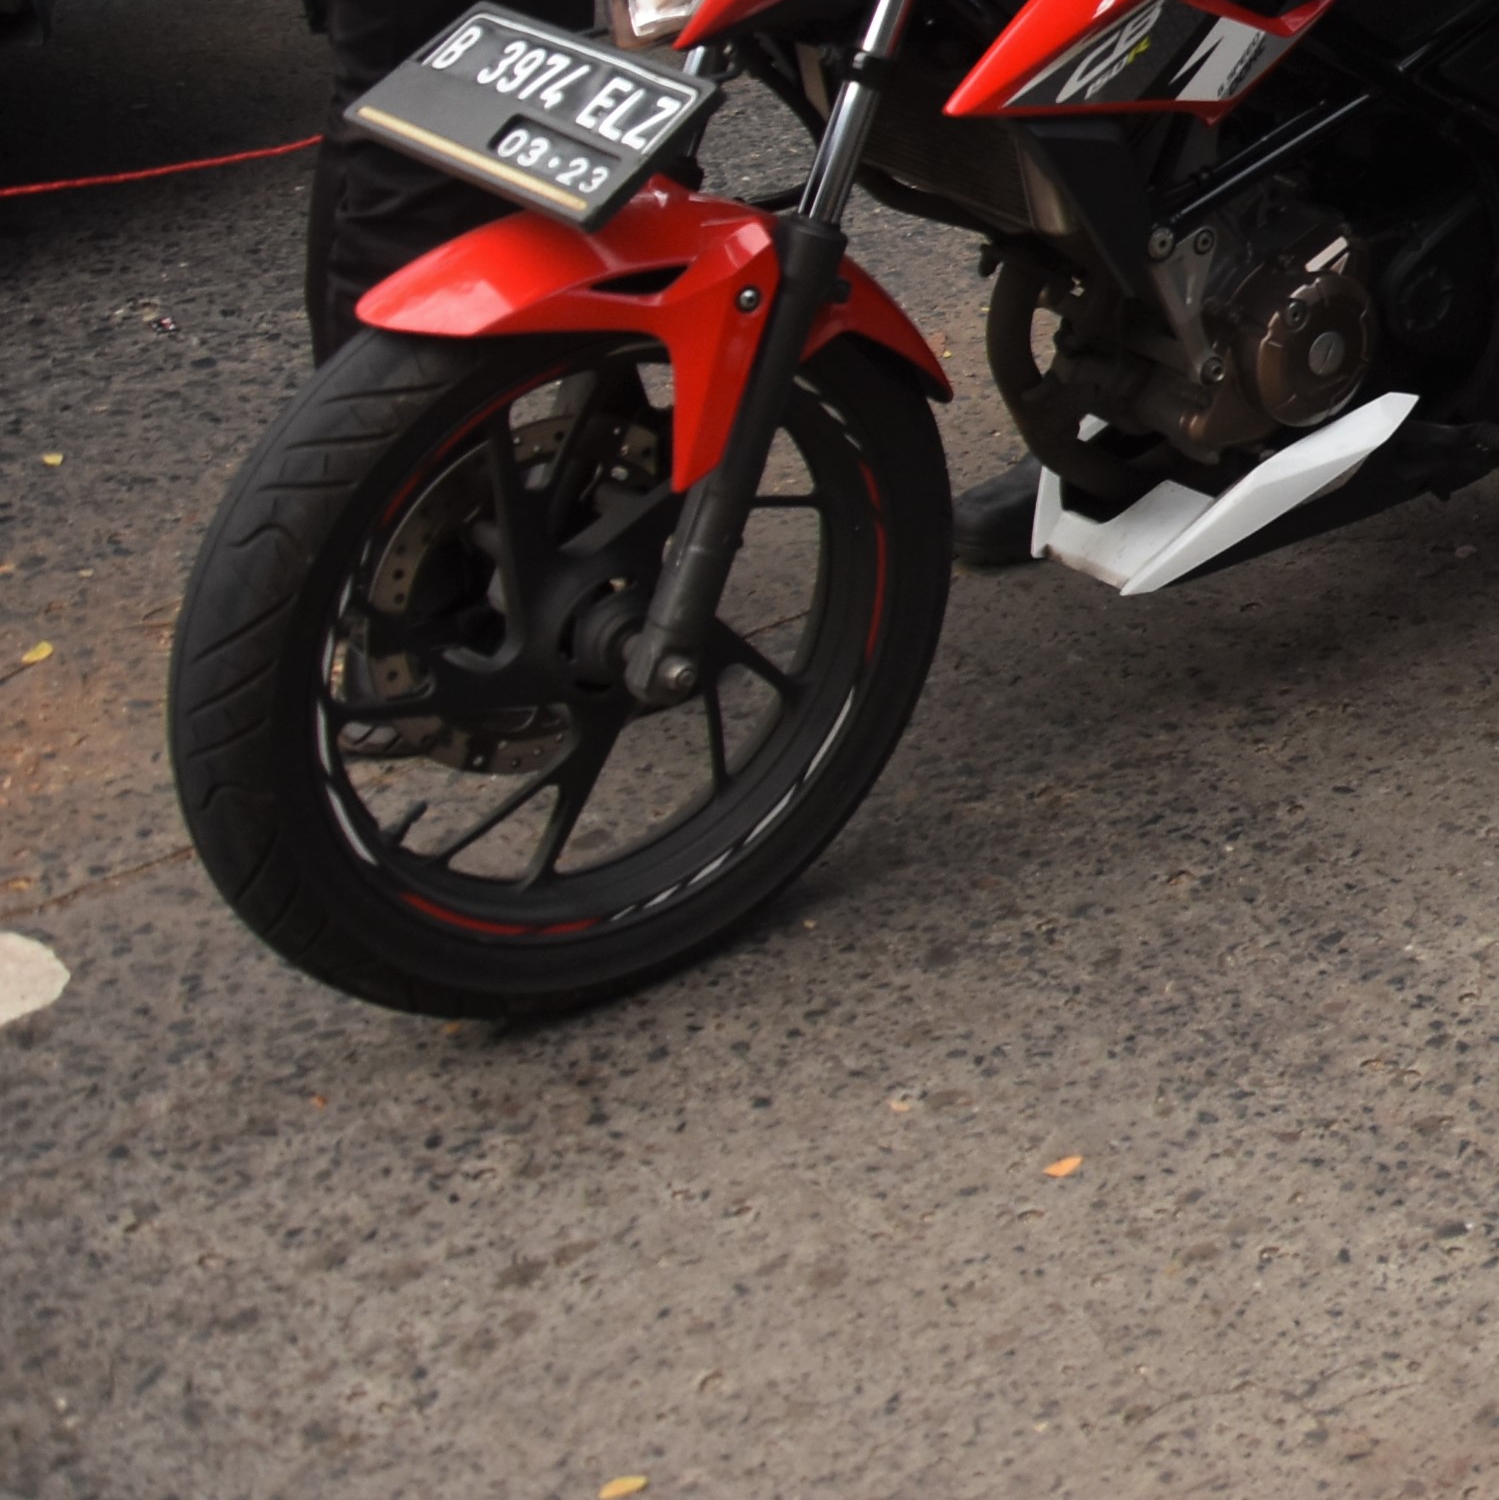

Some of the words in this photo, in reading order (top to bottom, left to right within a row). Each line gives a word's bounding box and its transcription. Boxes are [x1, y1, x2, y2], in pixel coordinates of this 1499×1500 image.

[432, 26, 483, 70] B
[477, 41, 590, 109] 3974
[576, 76, 682, 151] ELZ
[1085, 36, 1150, 100] 150R
